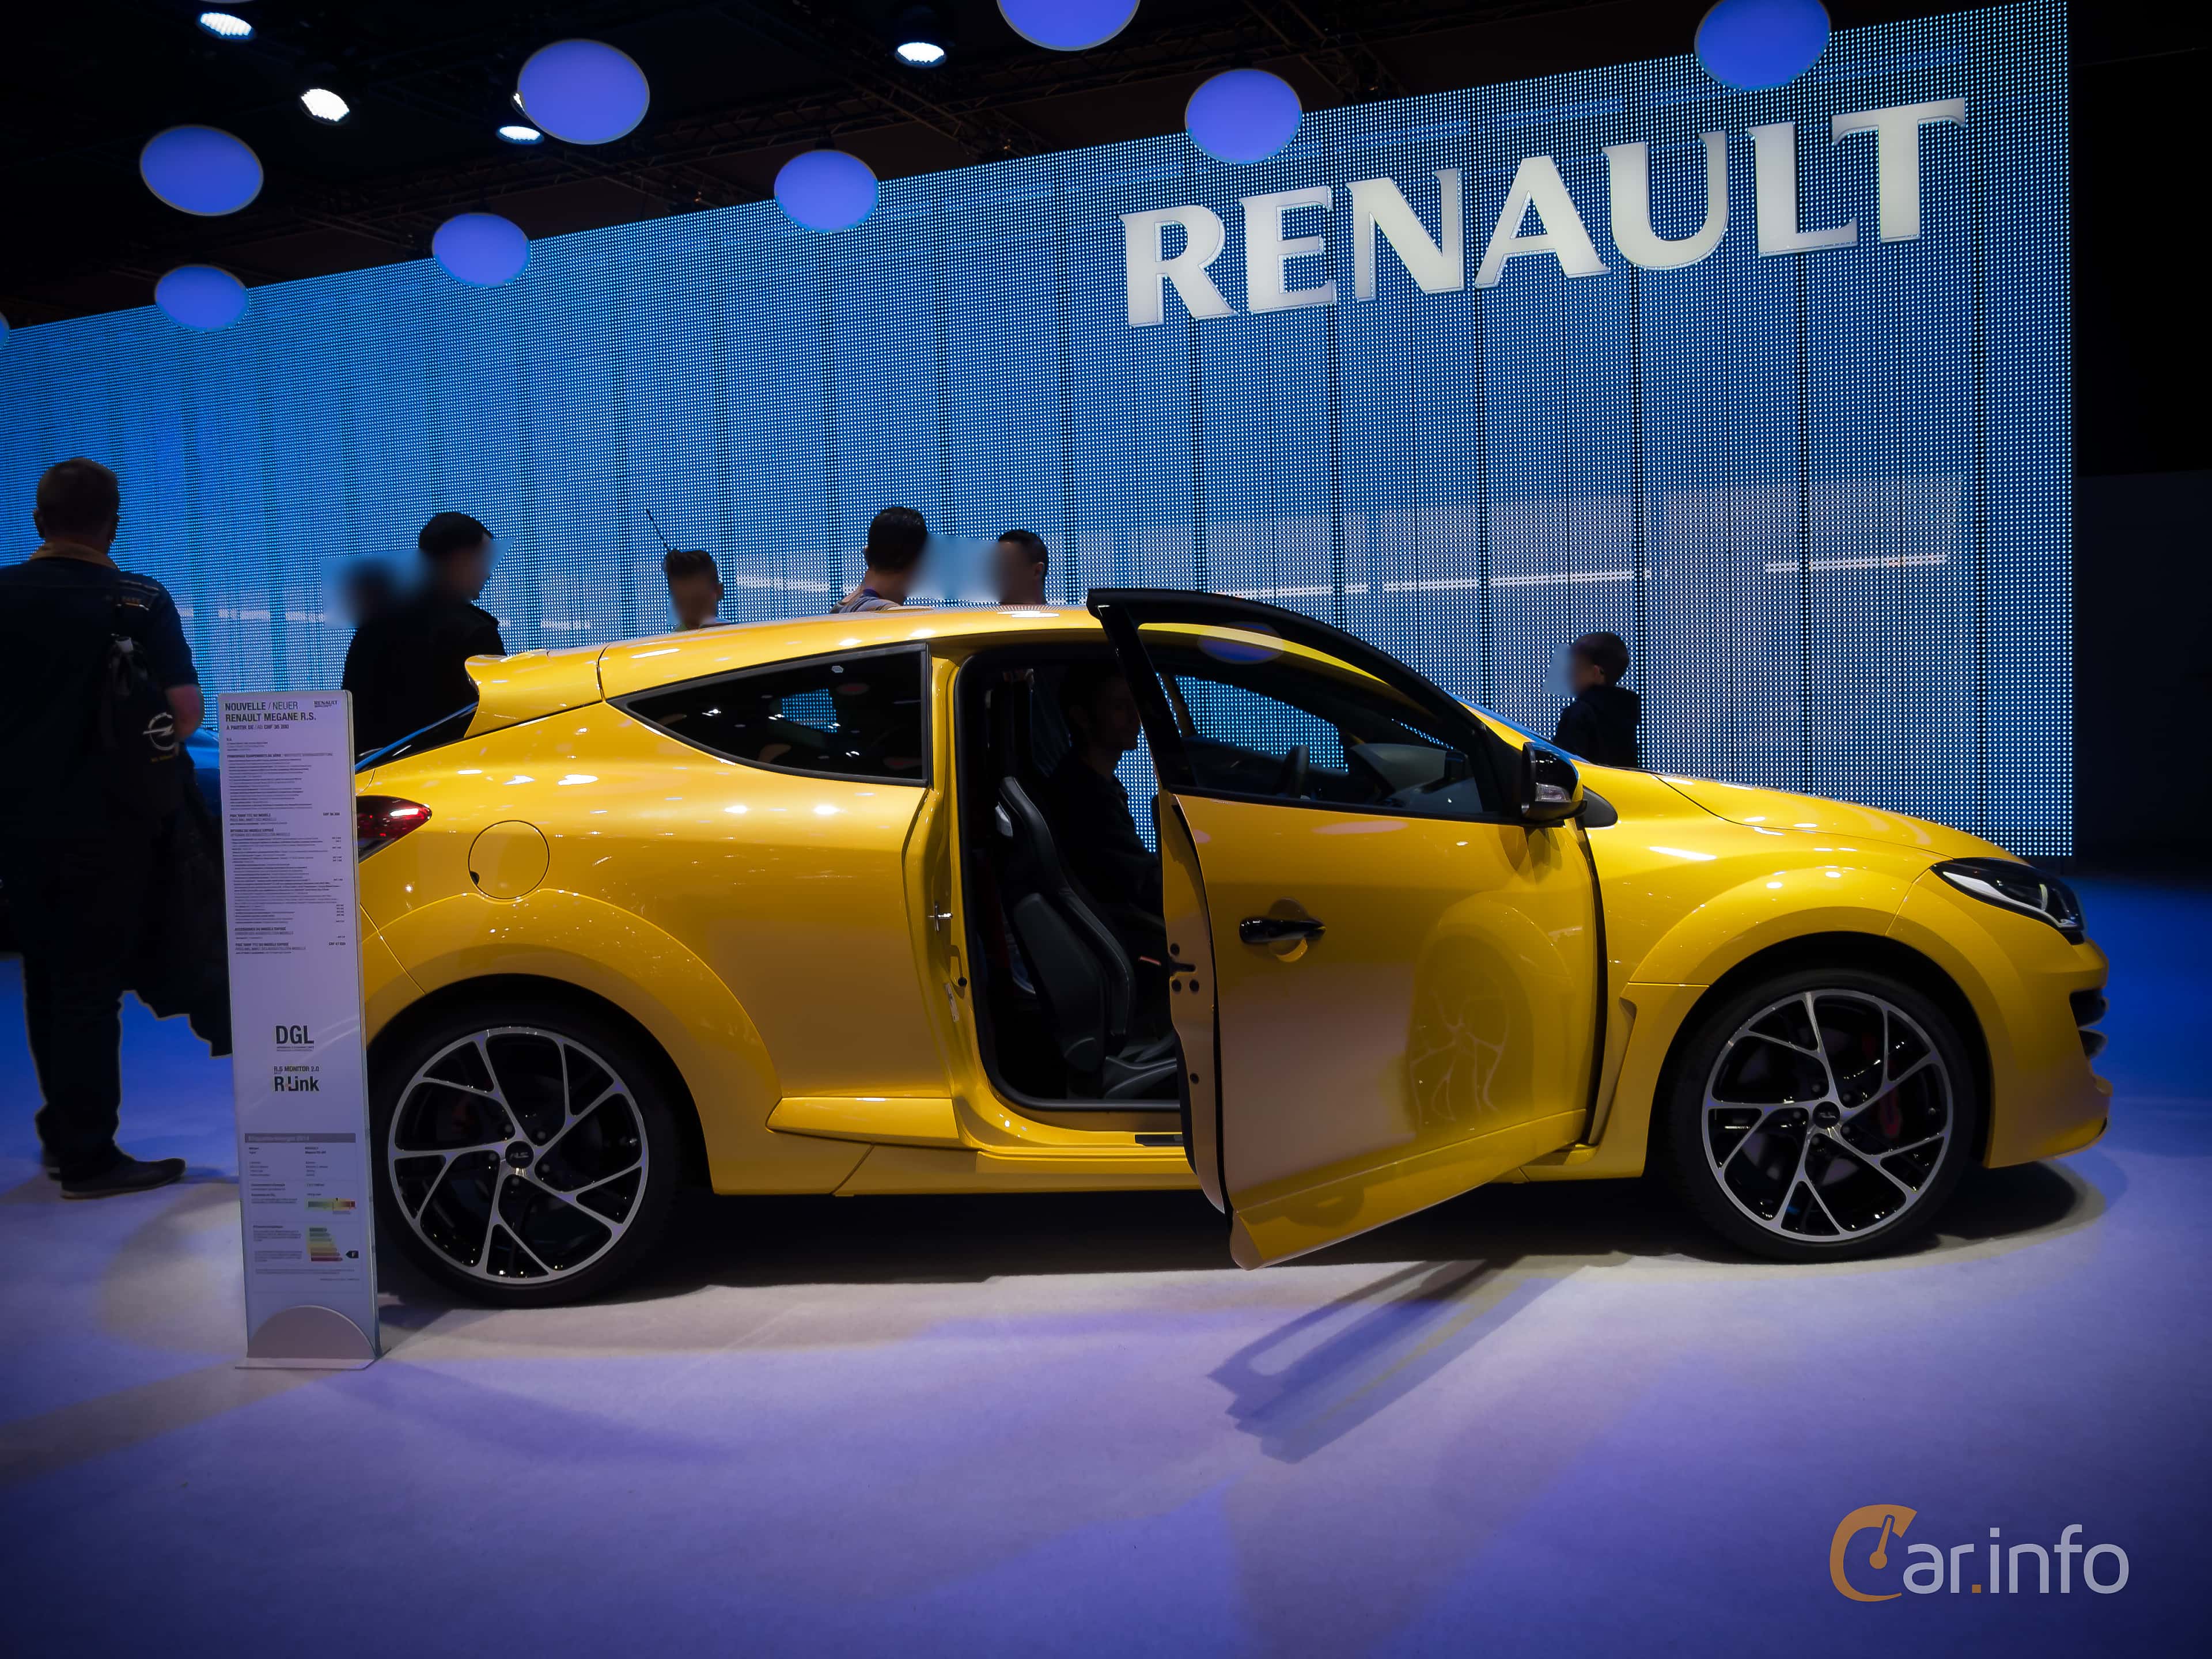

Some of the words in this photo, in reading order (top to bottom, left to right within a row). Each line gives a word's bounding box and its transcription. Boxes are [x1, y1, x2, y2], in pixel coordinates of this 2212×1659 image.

[1118, 97, 1966, 327] RENAULT
[225, 702, 266, 711] NOUVELLE
[272, 701, 298, 710] NEUER
[225, 713, 262, 722] RENAULT
[264, 712, 298, 721] MEGANE
[301, 711, 317, 721] R.S.
[275, 1025, 315, 1044] DGL
